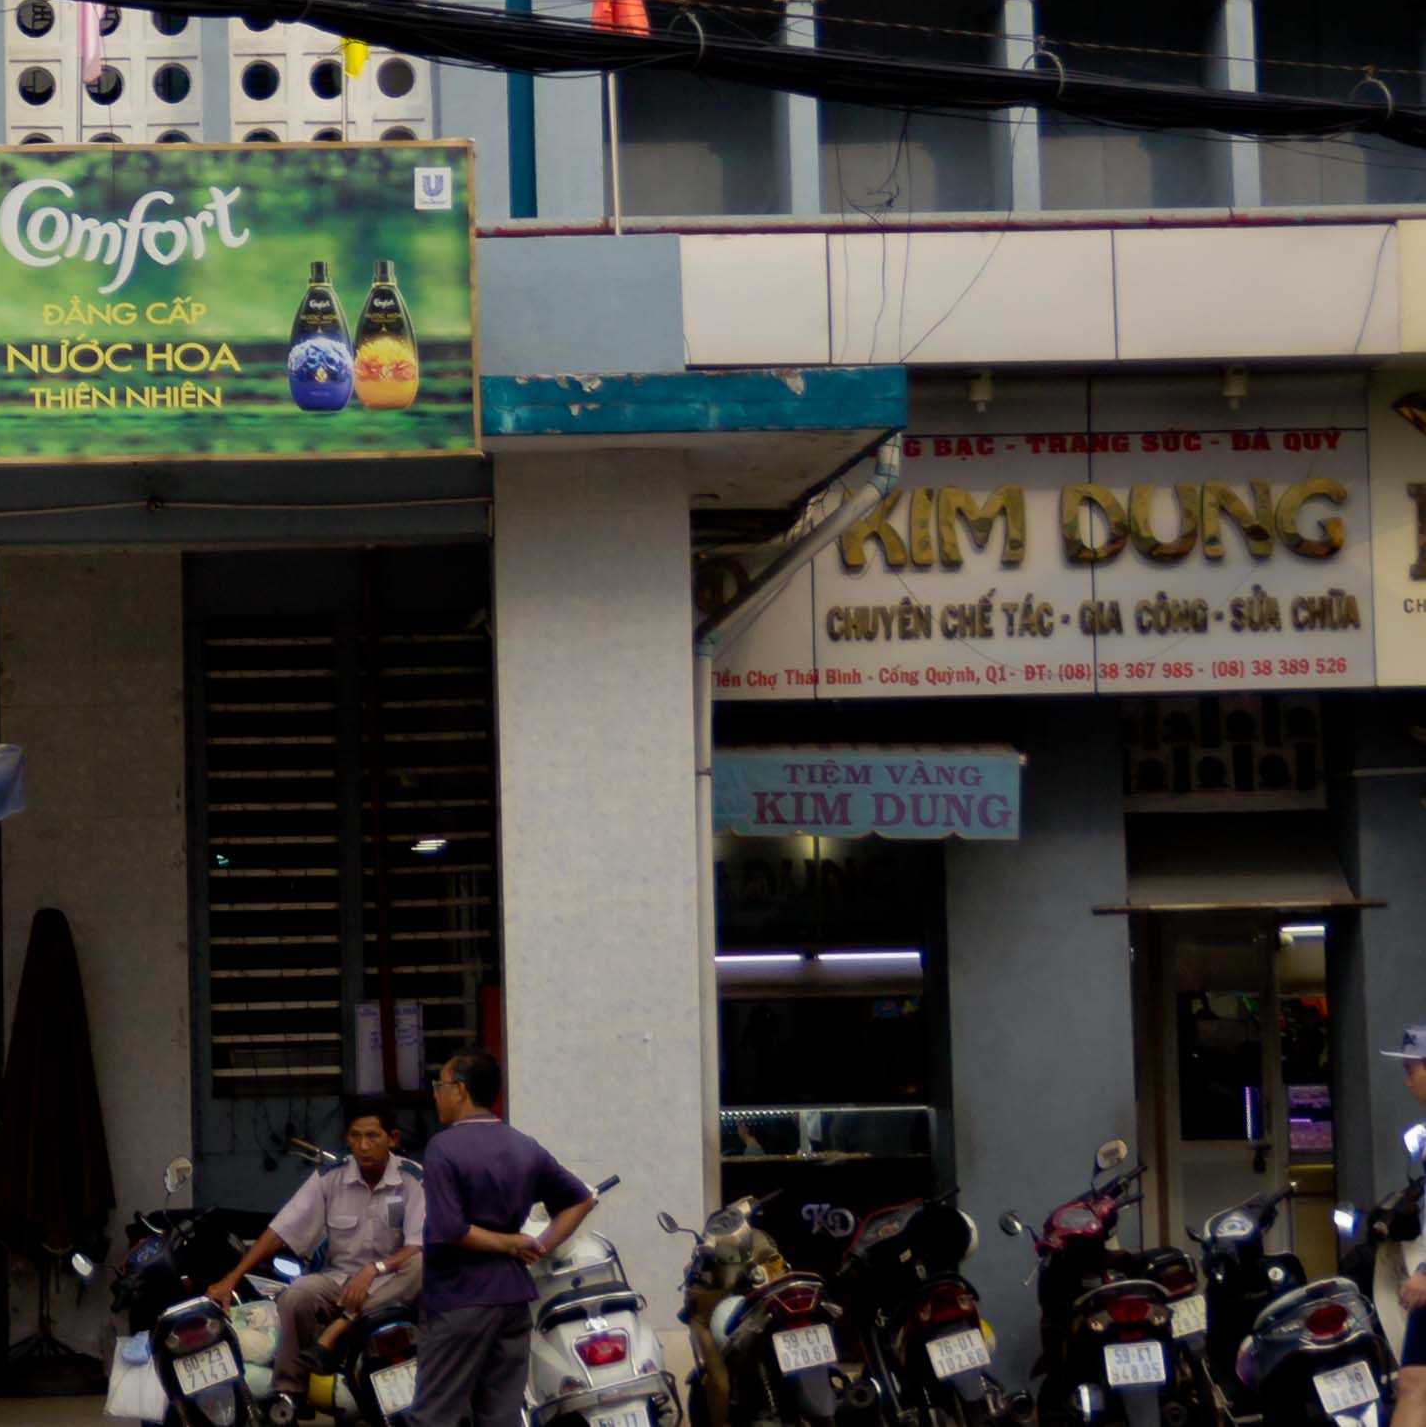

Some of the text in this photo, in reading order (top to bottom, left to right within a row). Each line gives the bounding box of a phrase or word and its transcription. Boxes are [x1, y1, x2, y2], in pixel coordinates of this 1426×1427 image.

[43, 294, 208, 325] ĐẲNG CẤP
[6, 334, 242, 373] NƯỚC HOA
[28, 380, 222, 409] THIÊN NHIÊN
[934, 435, 995, 462] BẠC
[1026, 433, 1129, 455] TRANG
[1141, 429, 1202, 452] SỨC
[840, 481, 1027, 568] KIM
[1059, 477, 1347, 565] DUNG
[826, 596, 933, 642] CHUYÊN
[1001, 593, 1054, 638] TÁC
[1079, 600, 1124, 635] GIA
[1059, 663, 1092, 683] (08)
[1098, 662, 1120, 679] 38
[1125, 662, 1155, 678] 367
[1162, 661, 1194, 678] 985
[1212, 660, 1245, 679] (08)
[1251, 659, 1273, 676] 38
[1278, 659, 1309, 675] 389
[1315, 658, 1347, 674] 526
[783, 760, 982, 788] TIỆM VÀNG
[752, 791, 1013, 829] KIM DUNG
